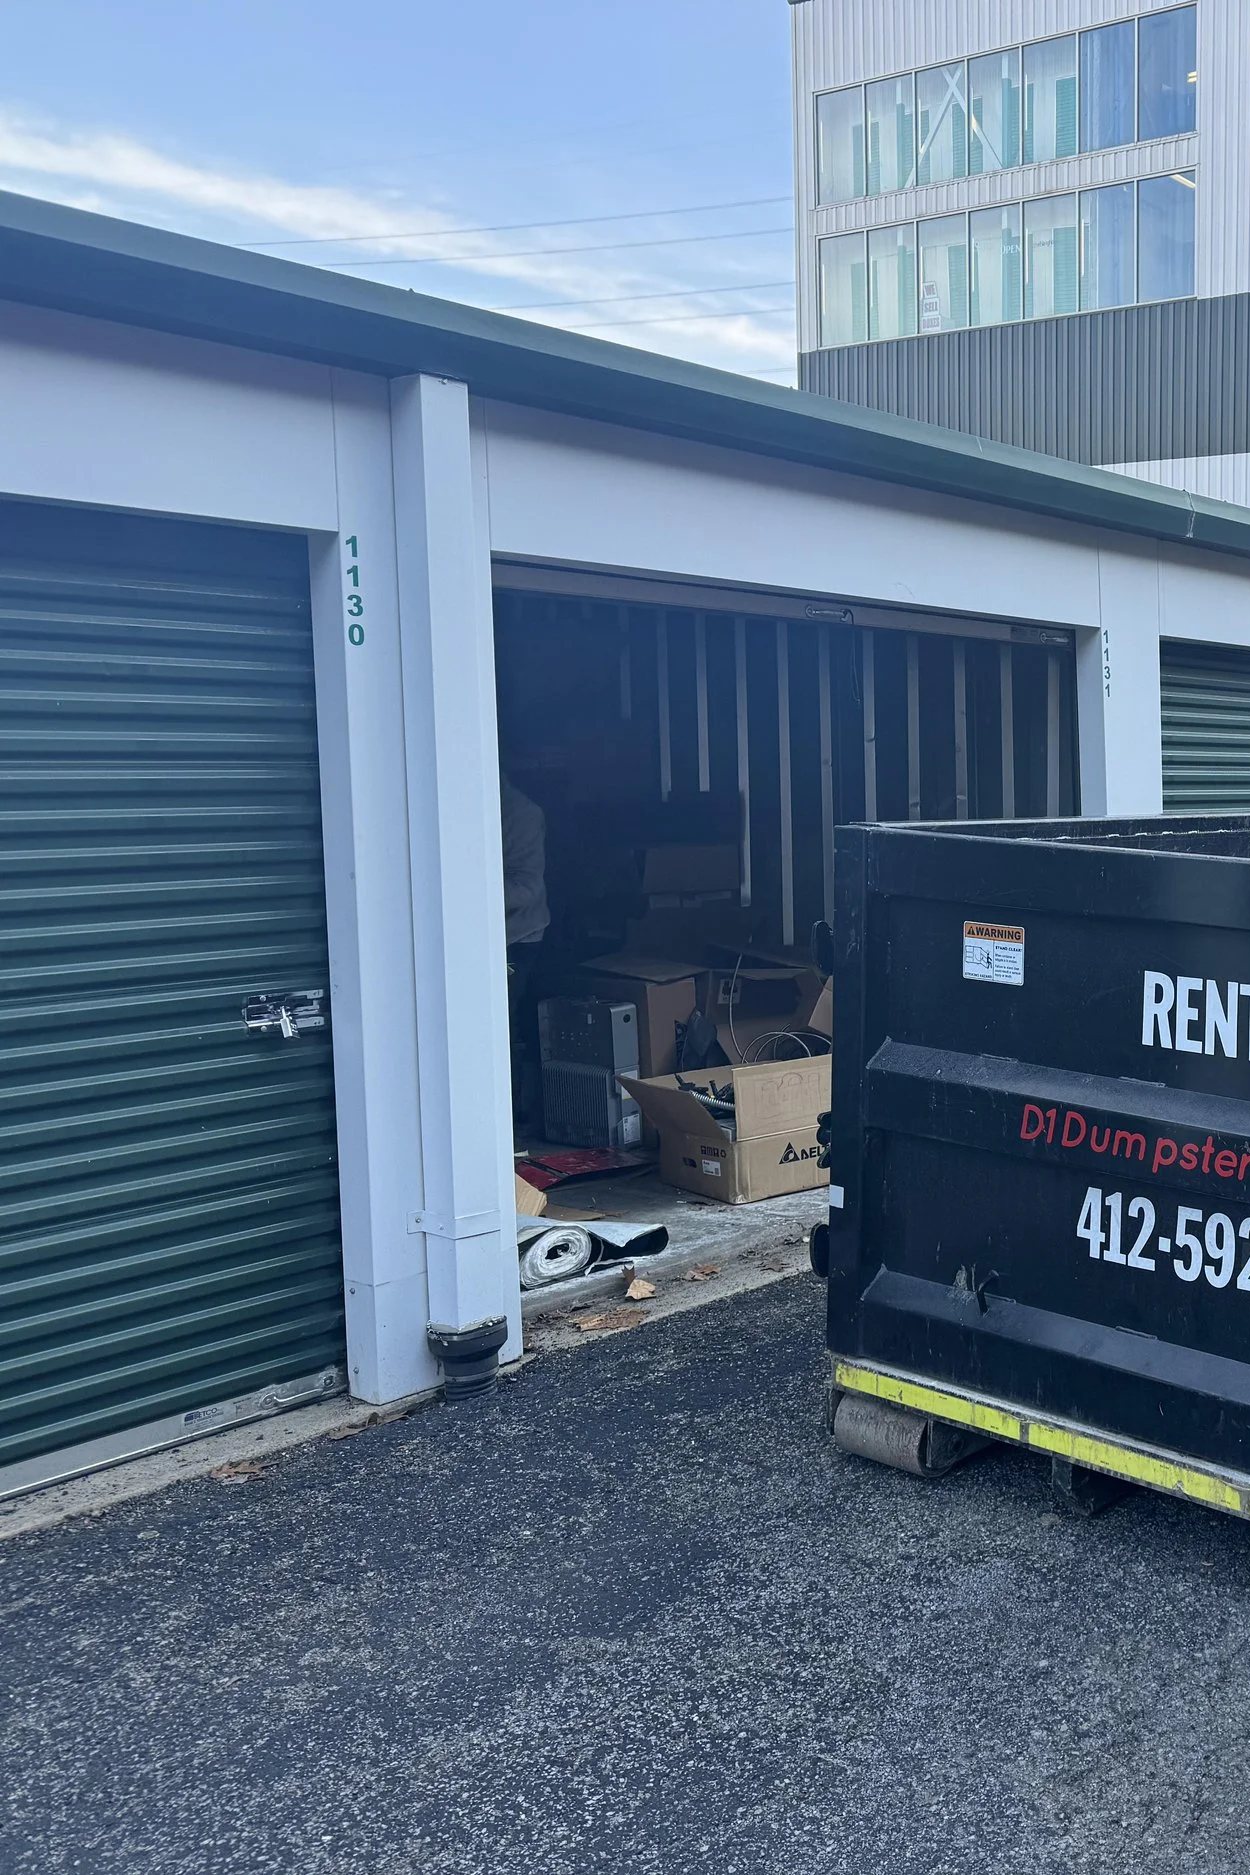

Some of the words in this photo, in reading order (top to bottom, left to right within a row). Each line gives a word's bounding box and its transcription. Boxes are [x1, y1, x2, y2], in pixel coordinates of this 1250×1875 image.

[345, 535, 365, 646] 1130
[1103, 629, 1111, 698] 1131
[976, 927, 1021, 940] WARNING
